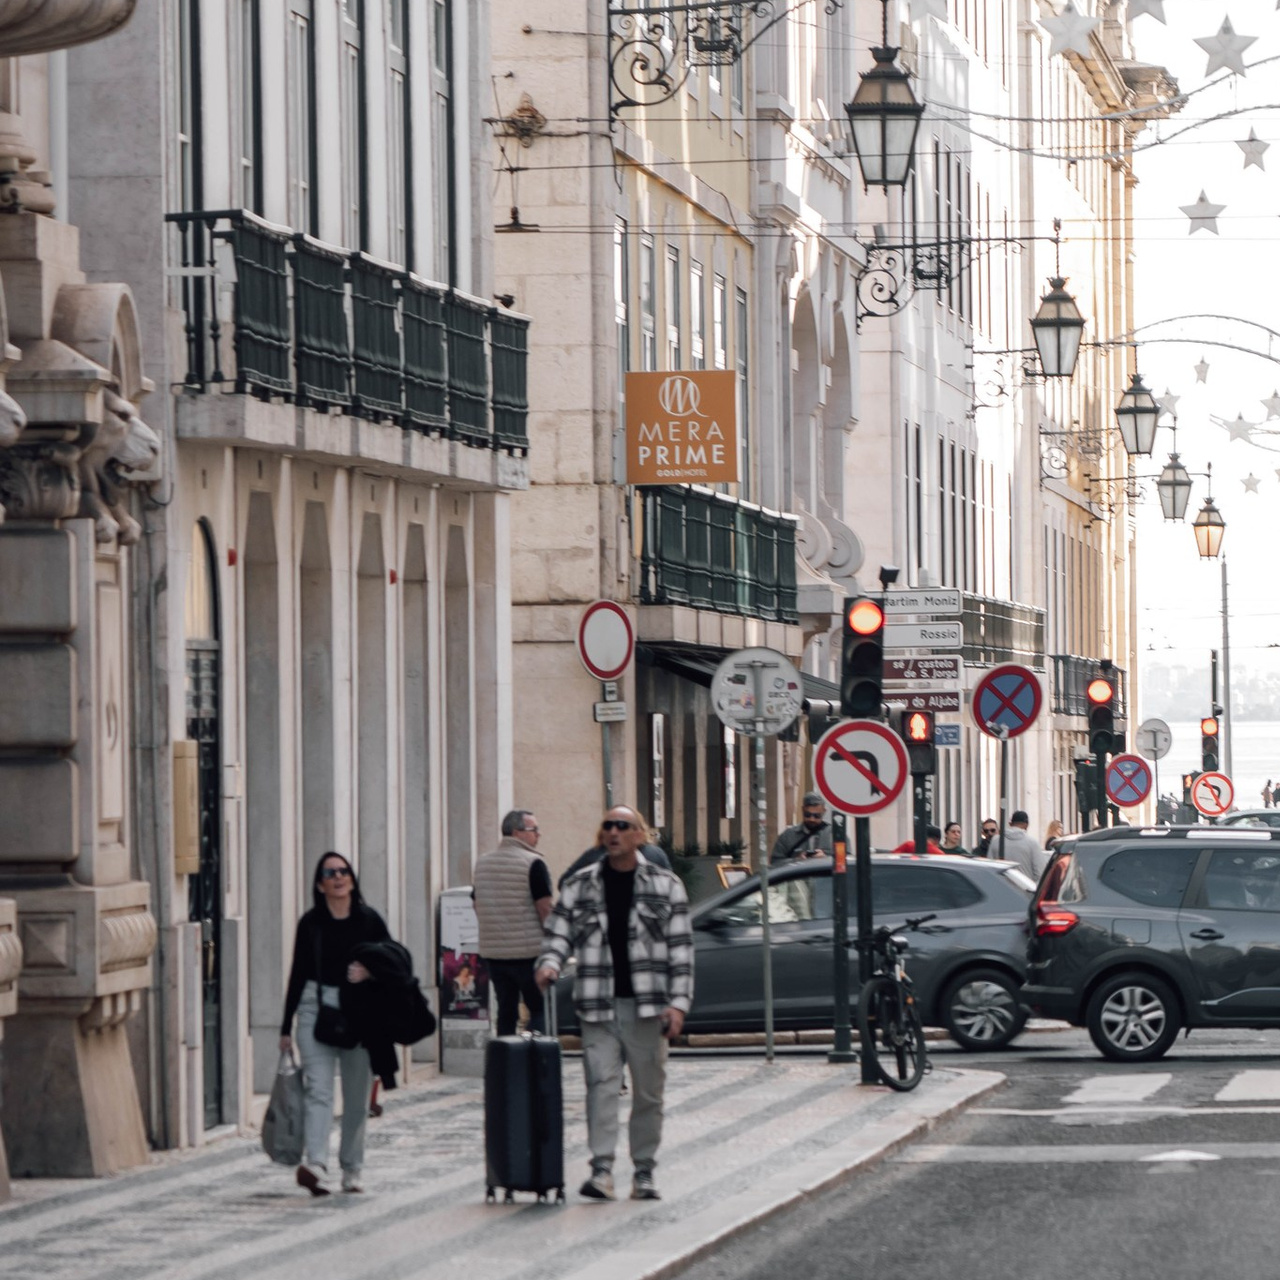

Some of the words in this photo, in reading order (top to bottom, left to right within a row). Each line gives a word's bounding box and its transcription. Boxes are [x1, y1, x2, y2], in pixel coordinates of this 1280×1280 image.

[638, 421, 724, 442] MERA
[638, 444, 725, 466] PRIME
[925, 595, 958, 607] Moniz
[920, 629, 958, 640] Rossio
[917, 659, 954, 669] castelo
[904, 669, 917, 678] de
[912, 696, 926, 708] do
